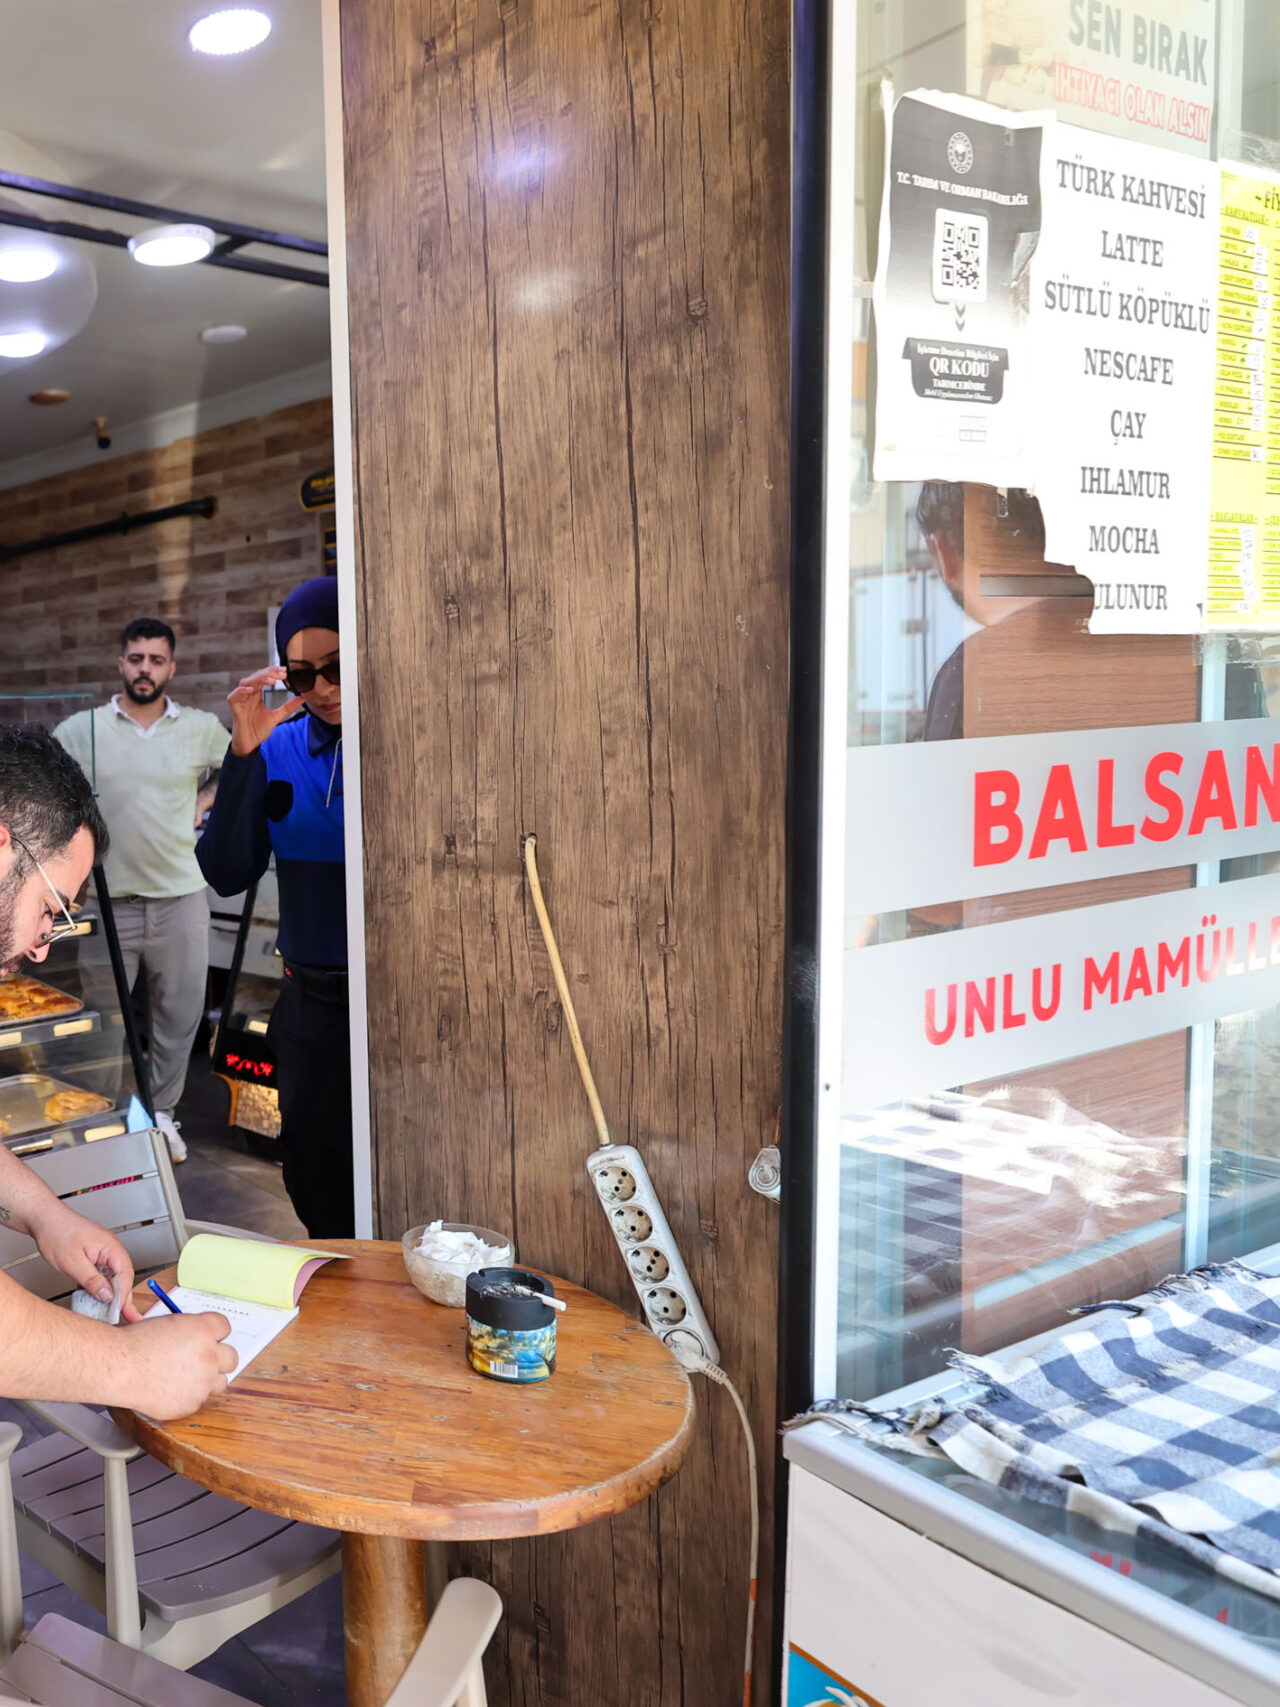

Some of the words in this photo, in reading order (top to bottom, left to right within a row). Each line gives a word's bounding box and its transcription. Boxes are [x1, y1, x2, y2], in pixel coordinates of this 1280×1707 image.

[1069, 0, 1122, 58] SEN
[1133, 14, 1208, 87] BIRAK
[1124, 83, 1165, 130] OLAN
[1168, 97, 1210, 143] ALSIN
[1057, 153, 1116, 200] TÜRK
[1121, 174, 1207, 220] KAHVESİ
[1101, 230, 1164, 268] LATTE
[1045, 273, 1112, 319] SÜTLÜ
[1118, 286, 1210, 334] KÖPÜKLÜ
[929, 356, 949, 377] QR
[950, 359, 990, 378] KODU
[1084, 347, 1174, 386] NESCAFE
[1110, 409, 1147, 446] ÇAY
[1080, 466, 1171, 500] IHLAMUR
[1089, 525, 1160, 555] MOCHA
[1094, 583, 1169, 611] ULUNUR
[973, 743, 1280, 867] BALSAN
[924, 963, 1062, 1046] UNLU
